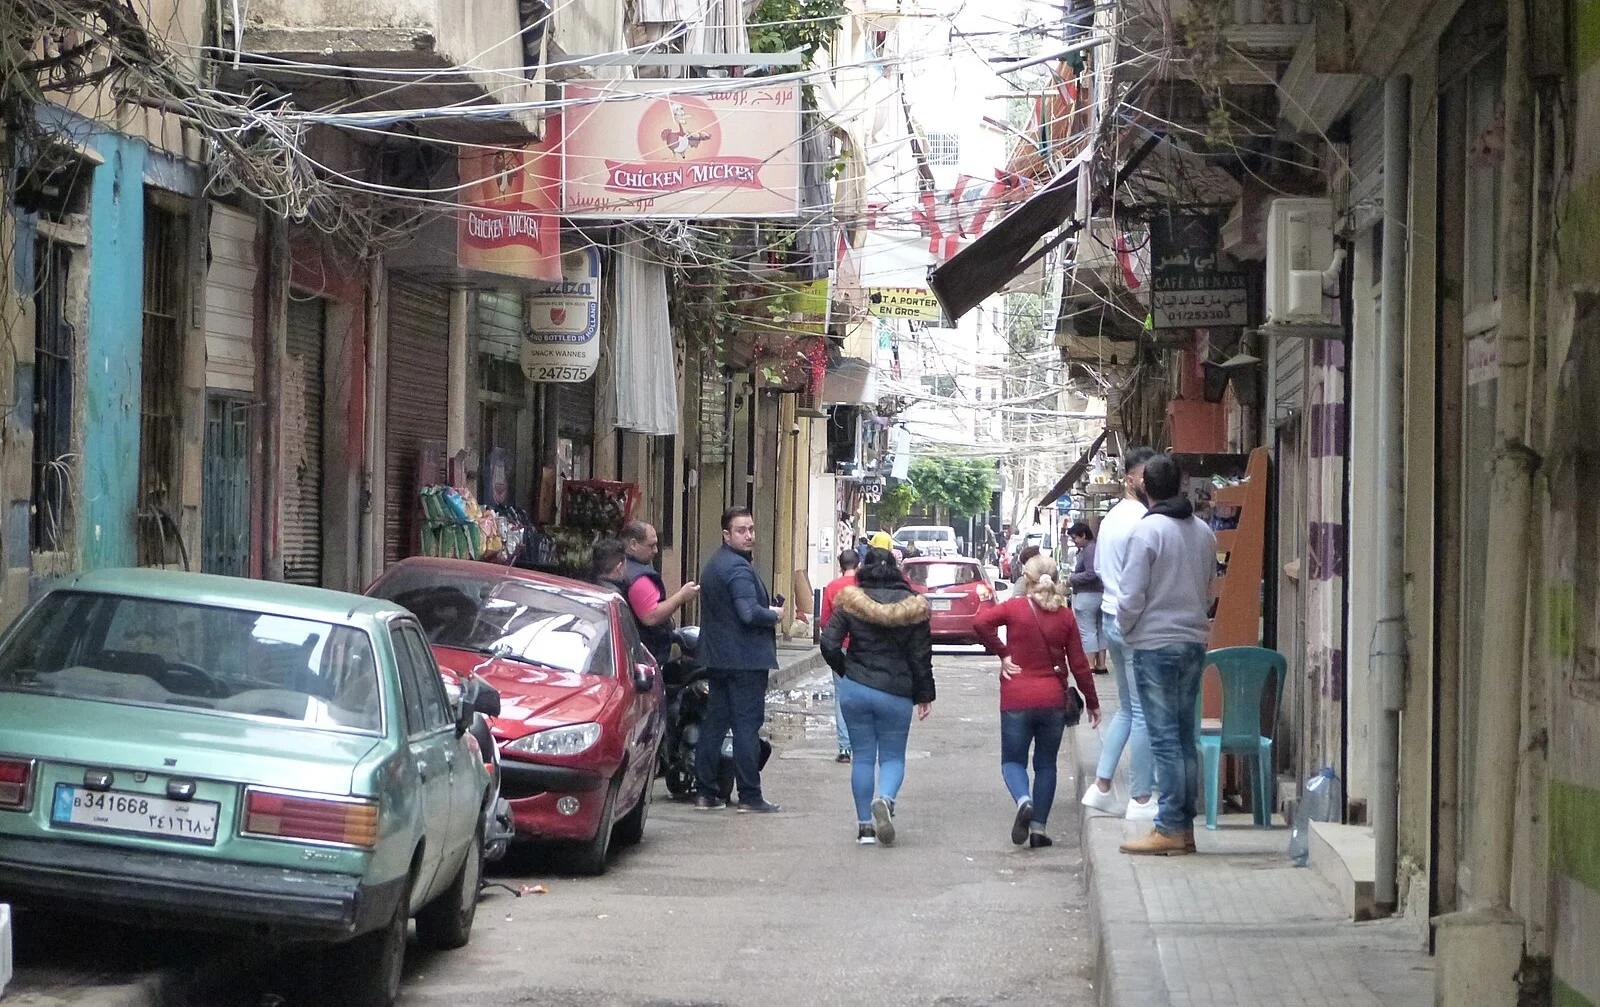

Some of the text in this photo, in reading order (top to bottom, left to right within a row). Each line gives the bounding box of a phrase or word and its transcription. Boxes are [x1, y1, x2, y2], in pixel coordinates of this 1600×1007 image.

[614, 162, 754, 189] CHICKEN MICKEN
[468, 211, 539, 243] CHICKEN MICKEN
[880, 306, 892, 314] EN
[890, 296, 897, 304] A
[900, 297, 938, 307] PORTER
[585, 302, 597, 339] HOLLAND
[555, 350, 586, 358] WANNES
[539, 367, 587, 380] 247575
[74, 792, 149, 815] B 341668
[148, 815, 205, 833] ٣٤١٦٦٨
